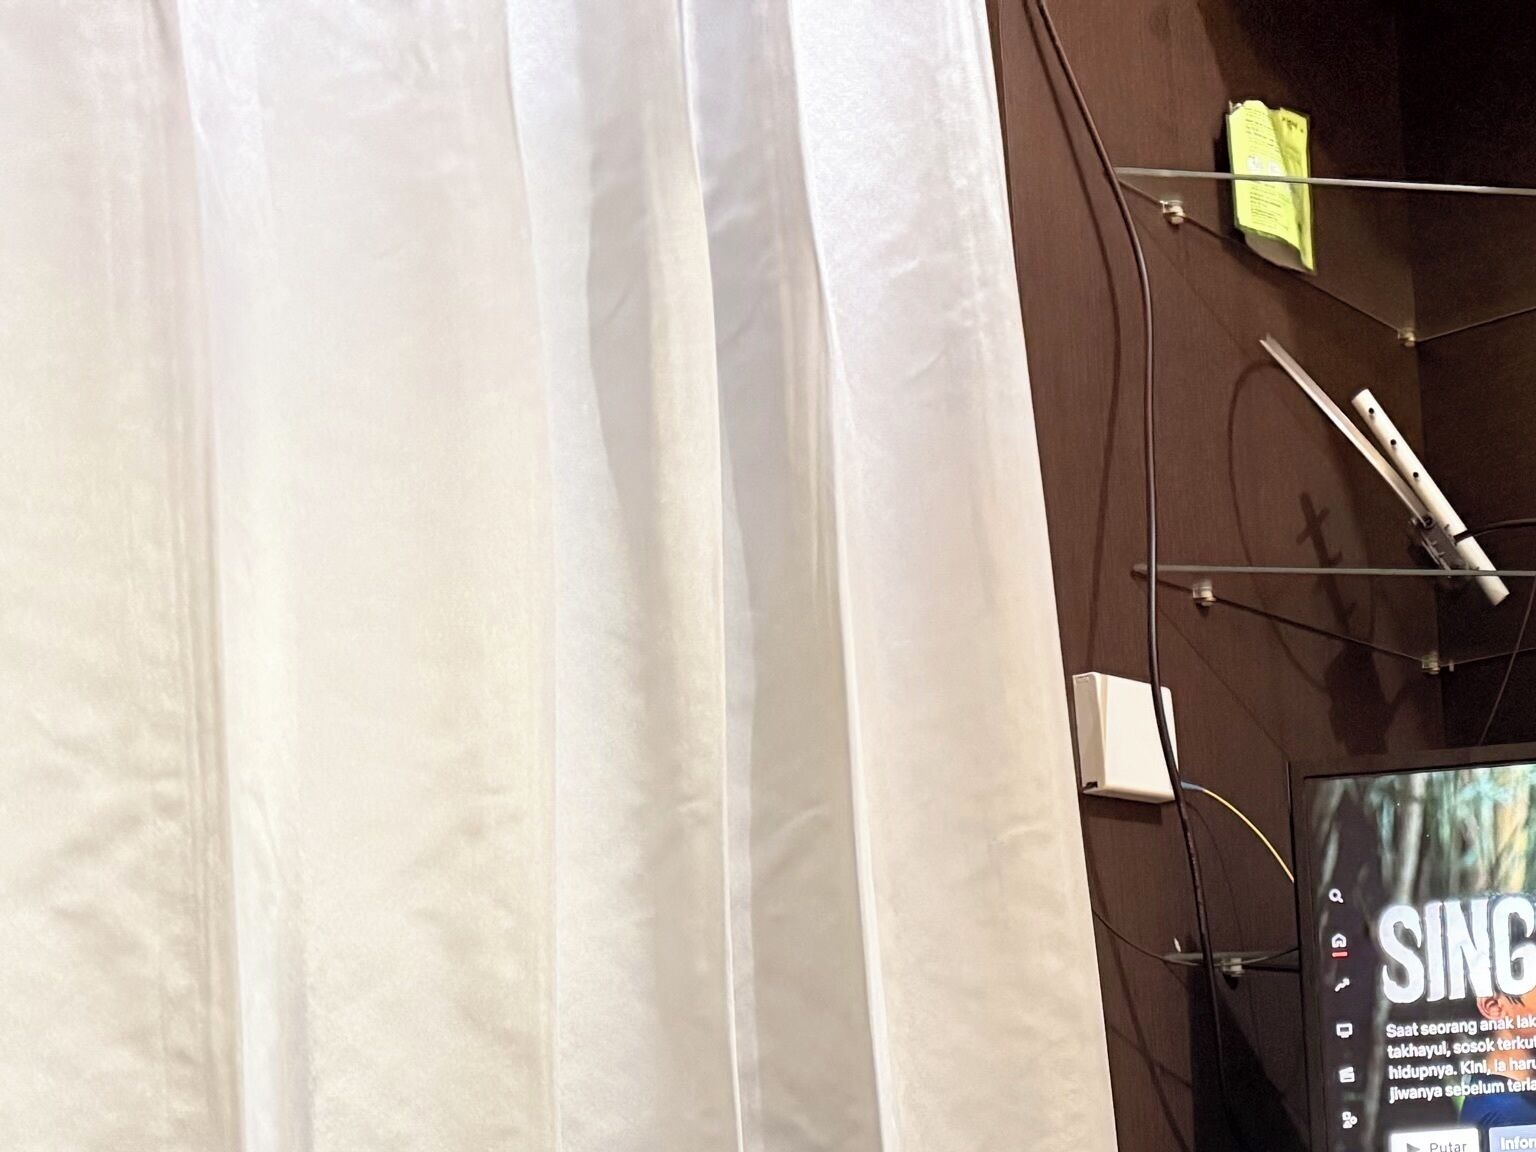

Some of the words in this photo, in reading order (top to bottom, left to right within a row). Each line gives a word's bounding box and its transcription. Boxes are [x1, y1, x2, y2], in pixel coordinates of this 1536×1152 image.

[1386, 1022, 1418, 1038] Saat
[1420, 1020, 1477, 1036] seorang
[1479, 1017, 1514, 1031] anak
[1453, 1038, 1495, 1054] sosok
[1388, 1064, 1458, 1081] hidupnya.
[1445, 1080, 1505, 1097] sebelum
